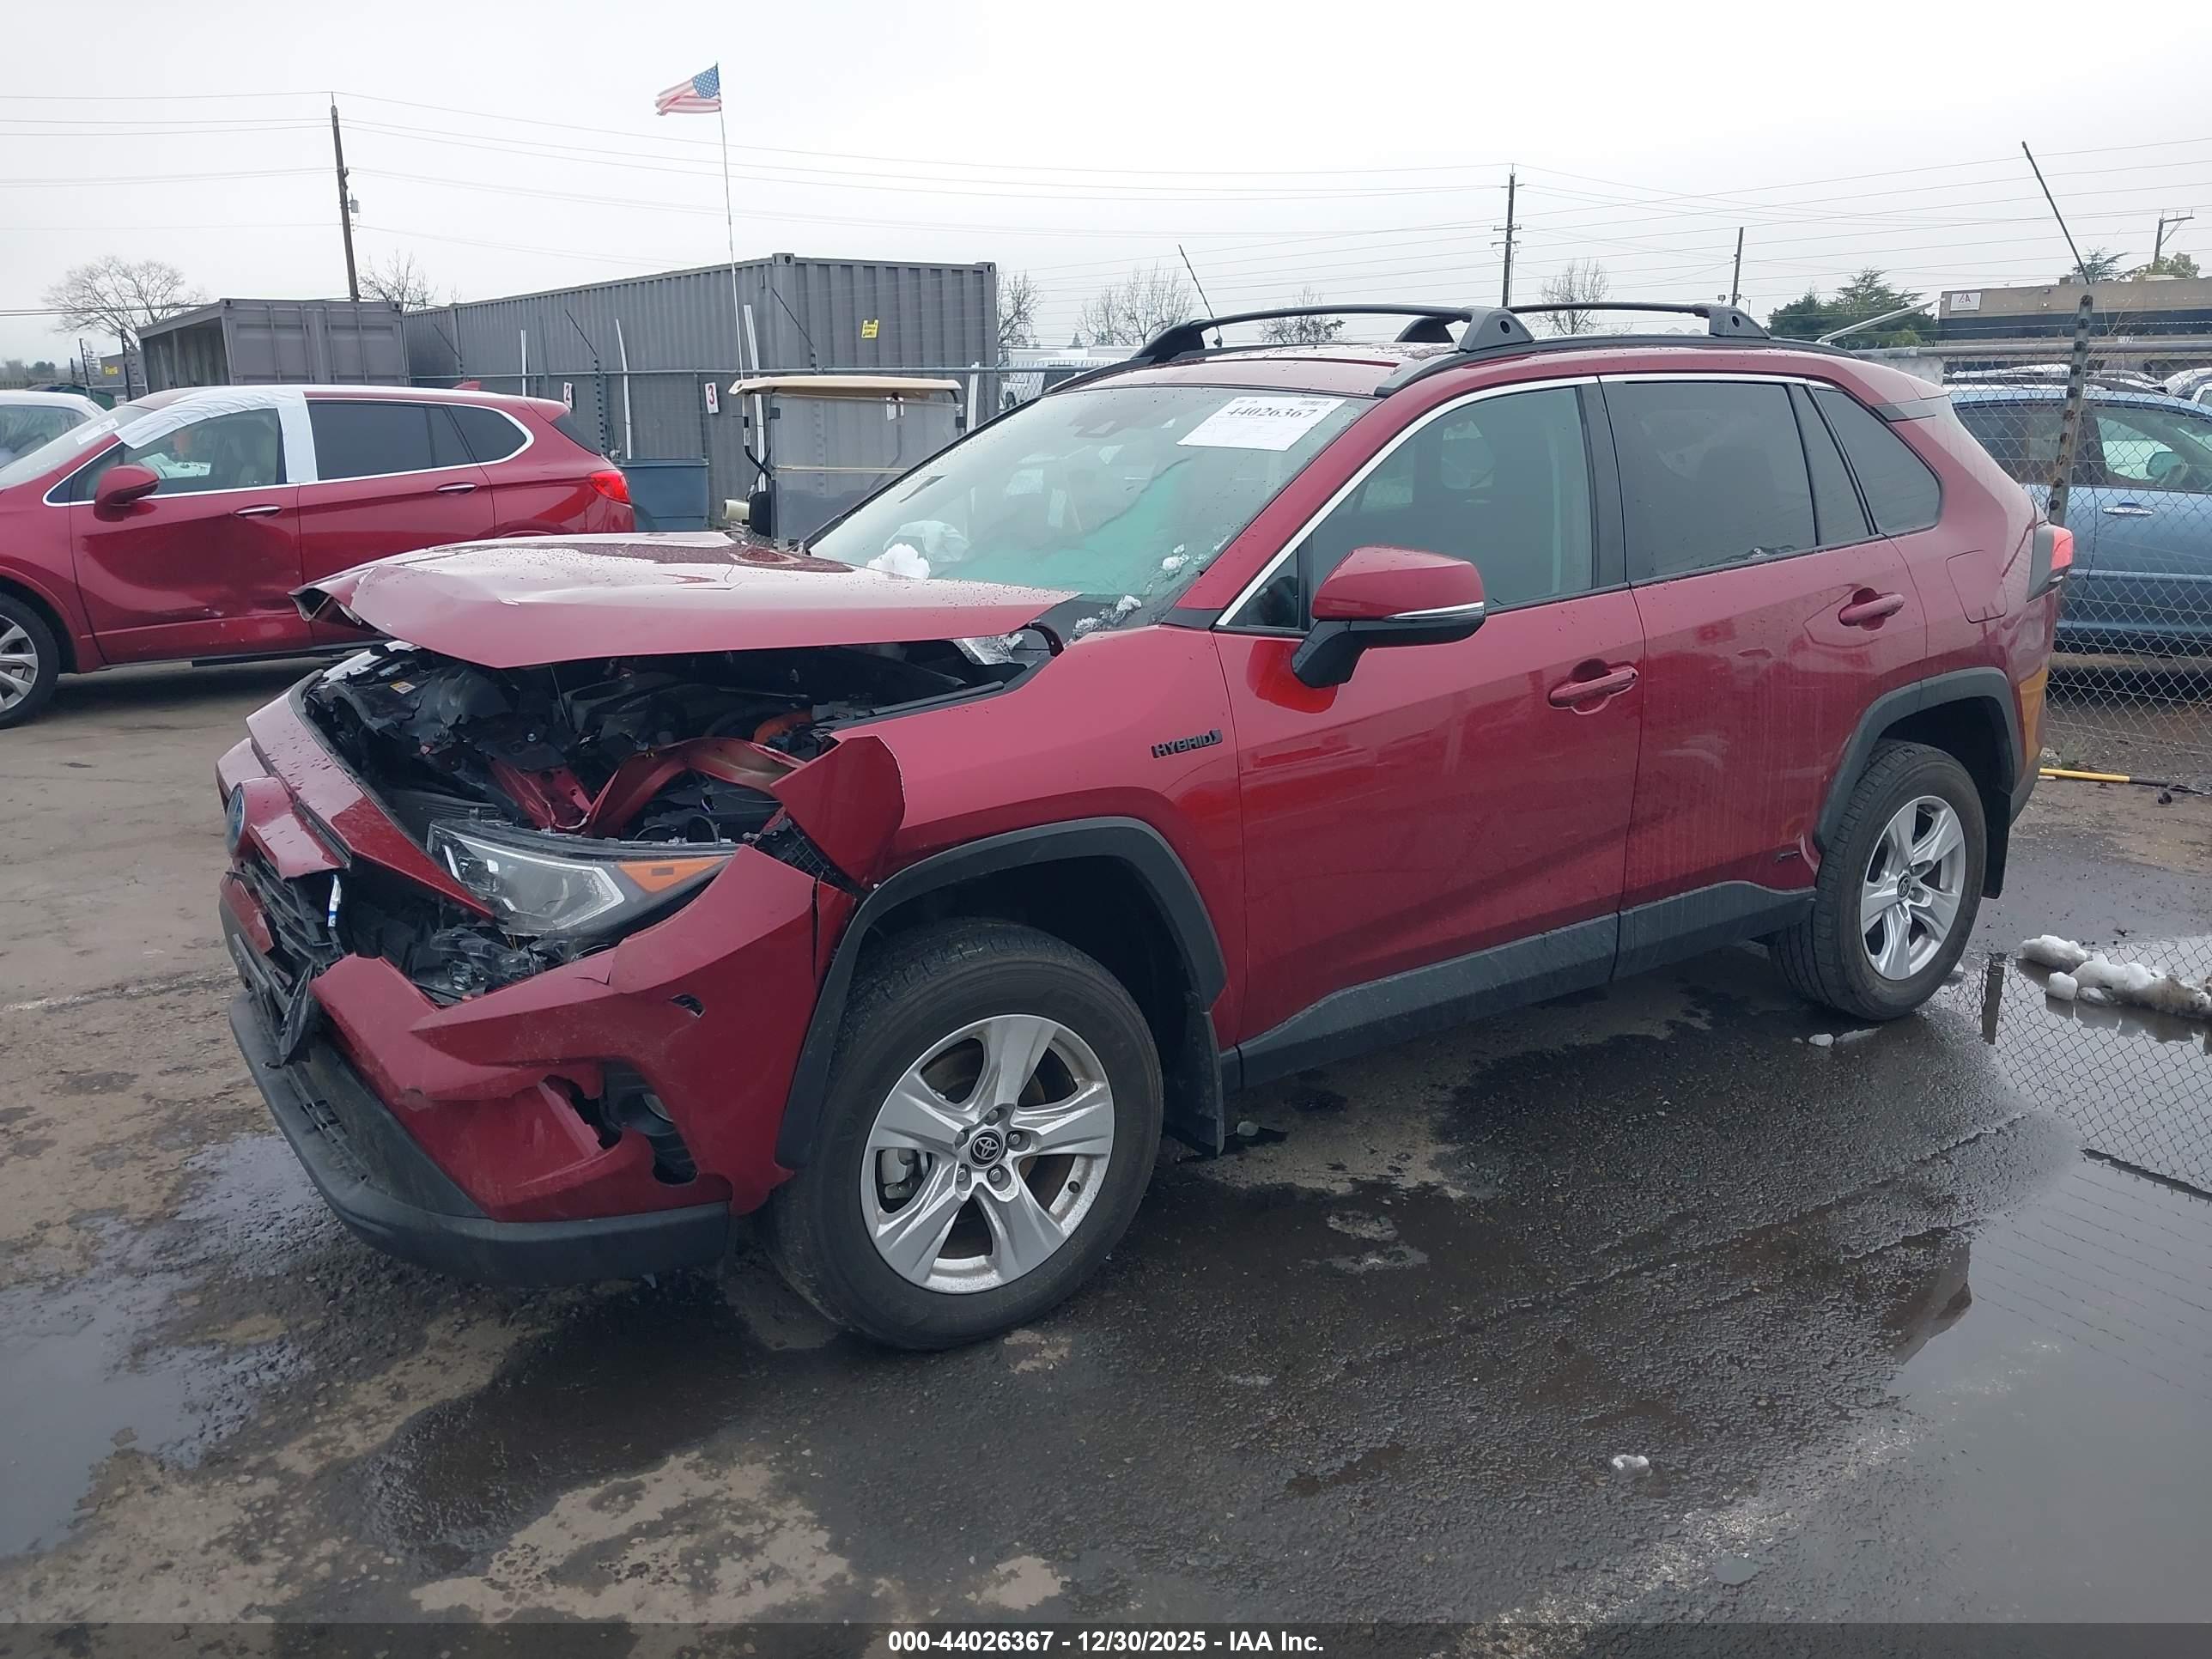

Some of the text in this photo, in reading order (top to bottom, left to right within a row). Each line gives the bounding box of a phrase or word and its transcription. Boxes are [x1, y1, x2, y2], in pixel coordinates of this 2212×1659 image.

[565, 384, 570, 402] 2
[708, 384, 715, 405] 3
[1227, 406, 1318, 419] 44026367
[1151, 733, 1212, 758] HYBRID
